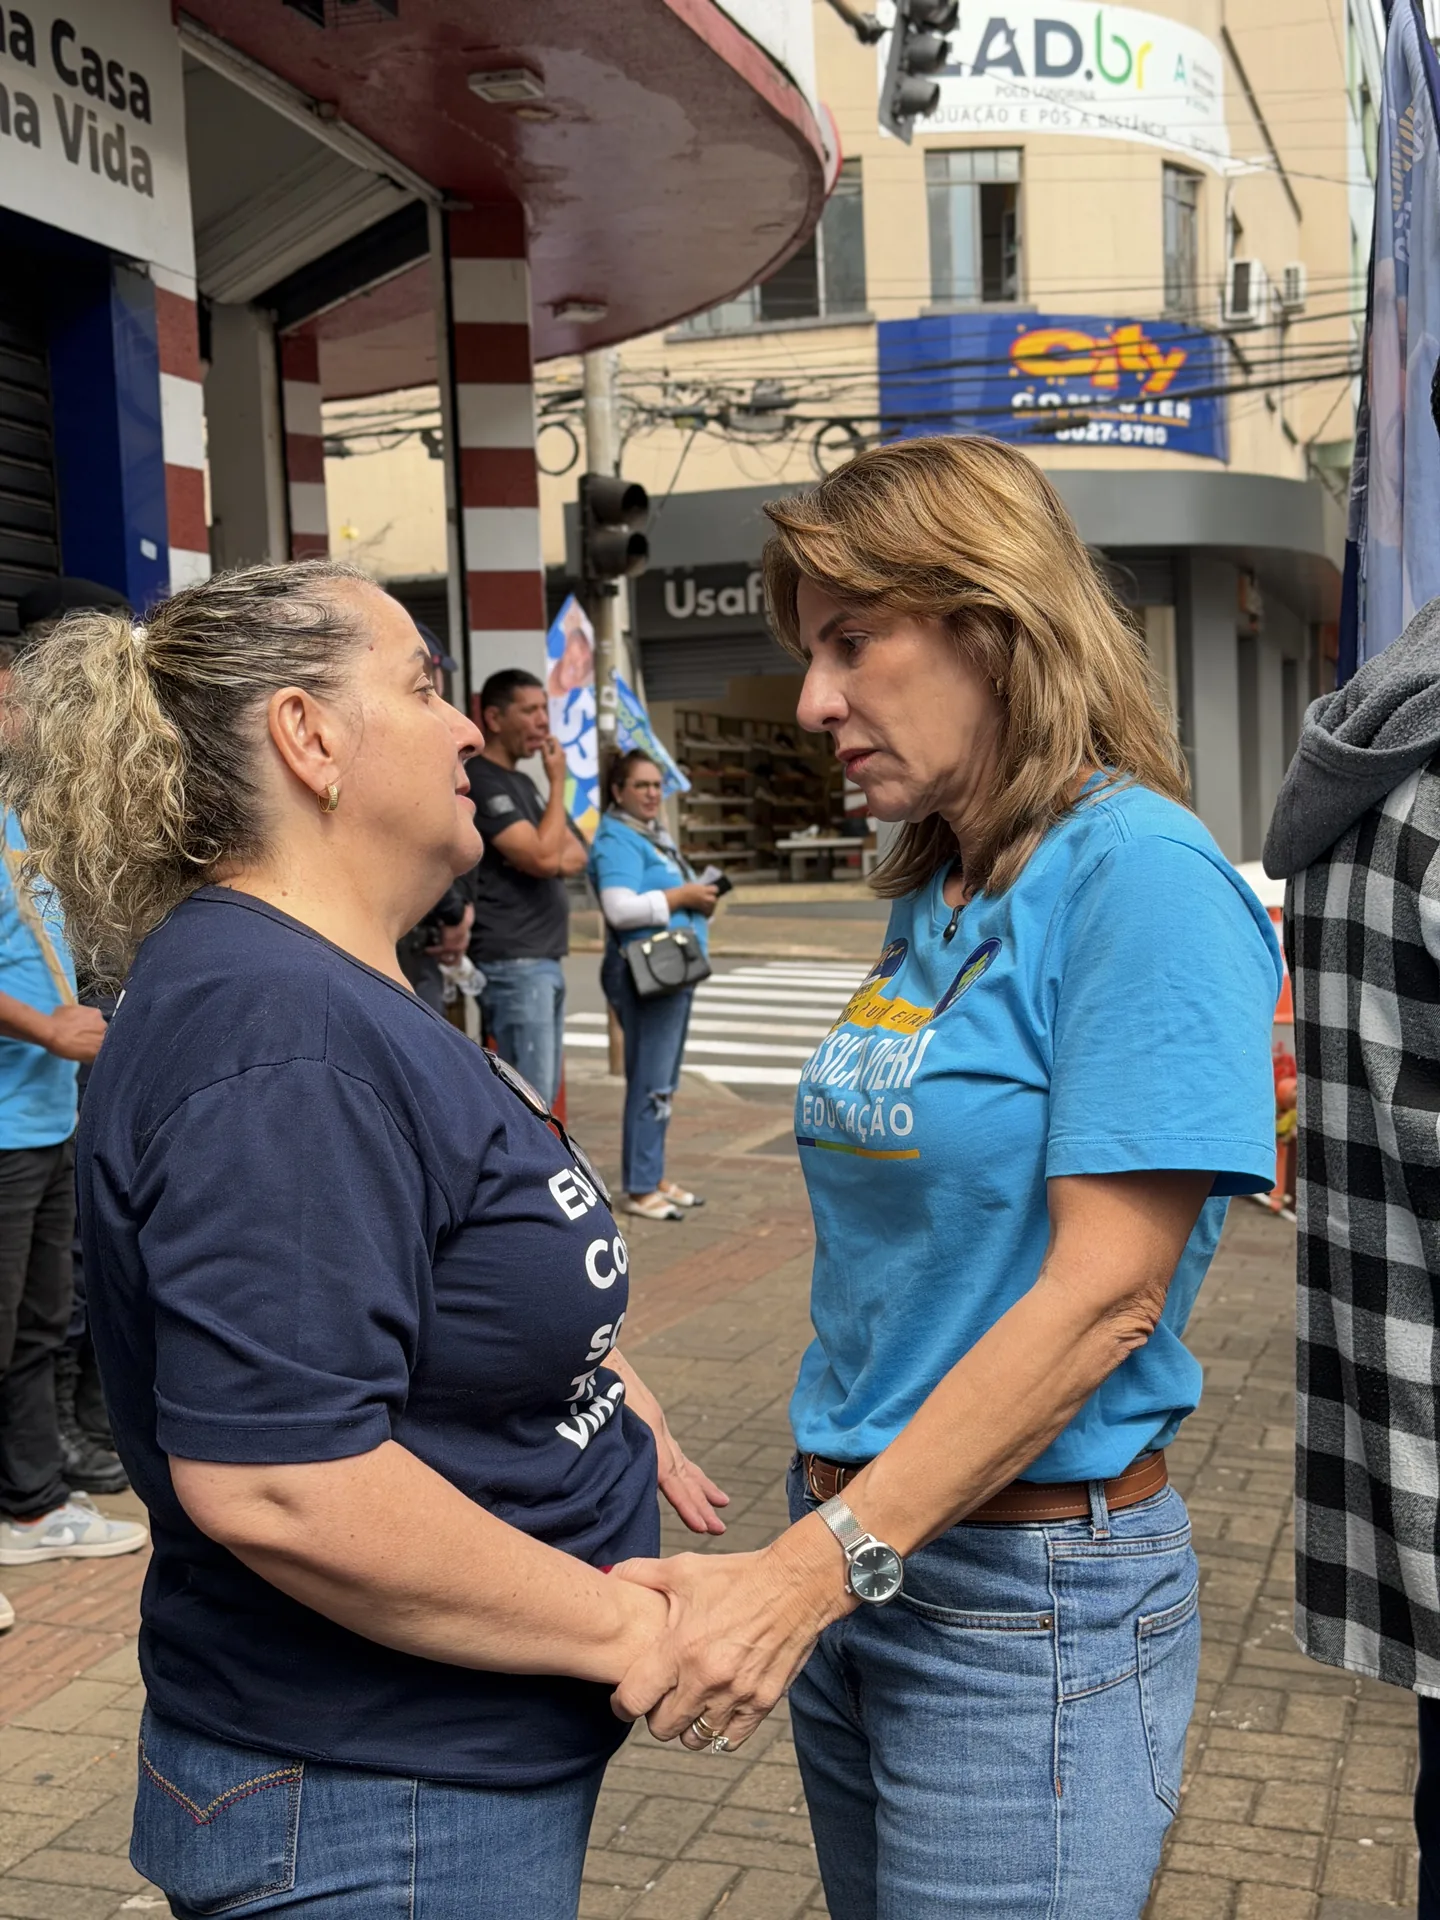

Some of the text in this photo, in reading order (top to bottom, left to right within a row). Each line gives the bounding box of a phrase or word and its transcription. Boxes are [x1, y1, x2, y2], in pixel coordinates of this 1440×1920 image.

[0, 3, 152, 125] a Casa
[933, 8, 1153, 90] AD.br
[53, 93, 153, 198] Vida
[921, 105, 1008, 126] DUAÇÃO
[1020, 108, 1029, 123] E
[1009, 323, 1188, 392] City
[802, 1096, 914, 1143] EDUCAÇÃO
